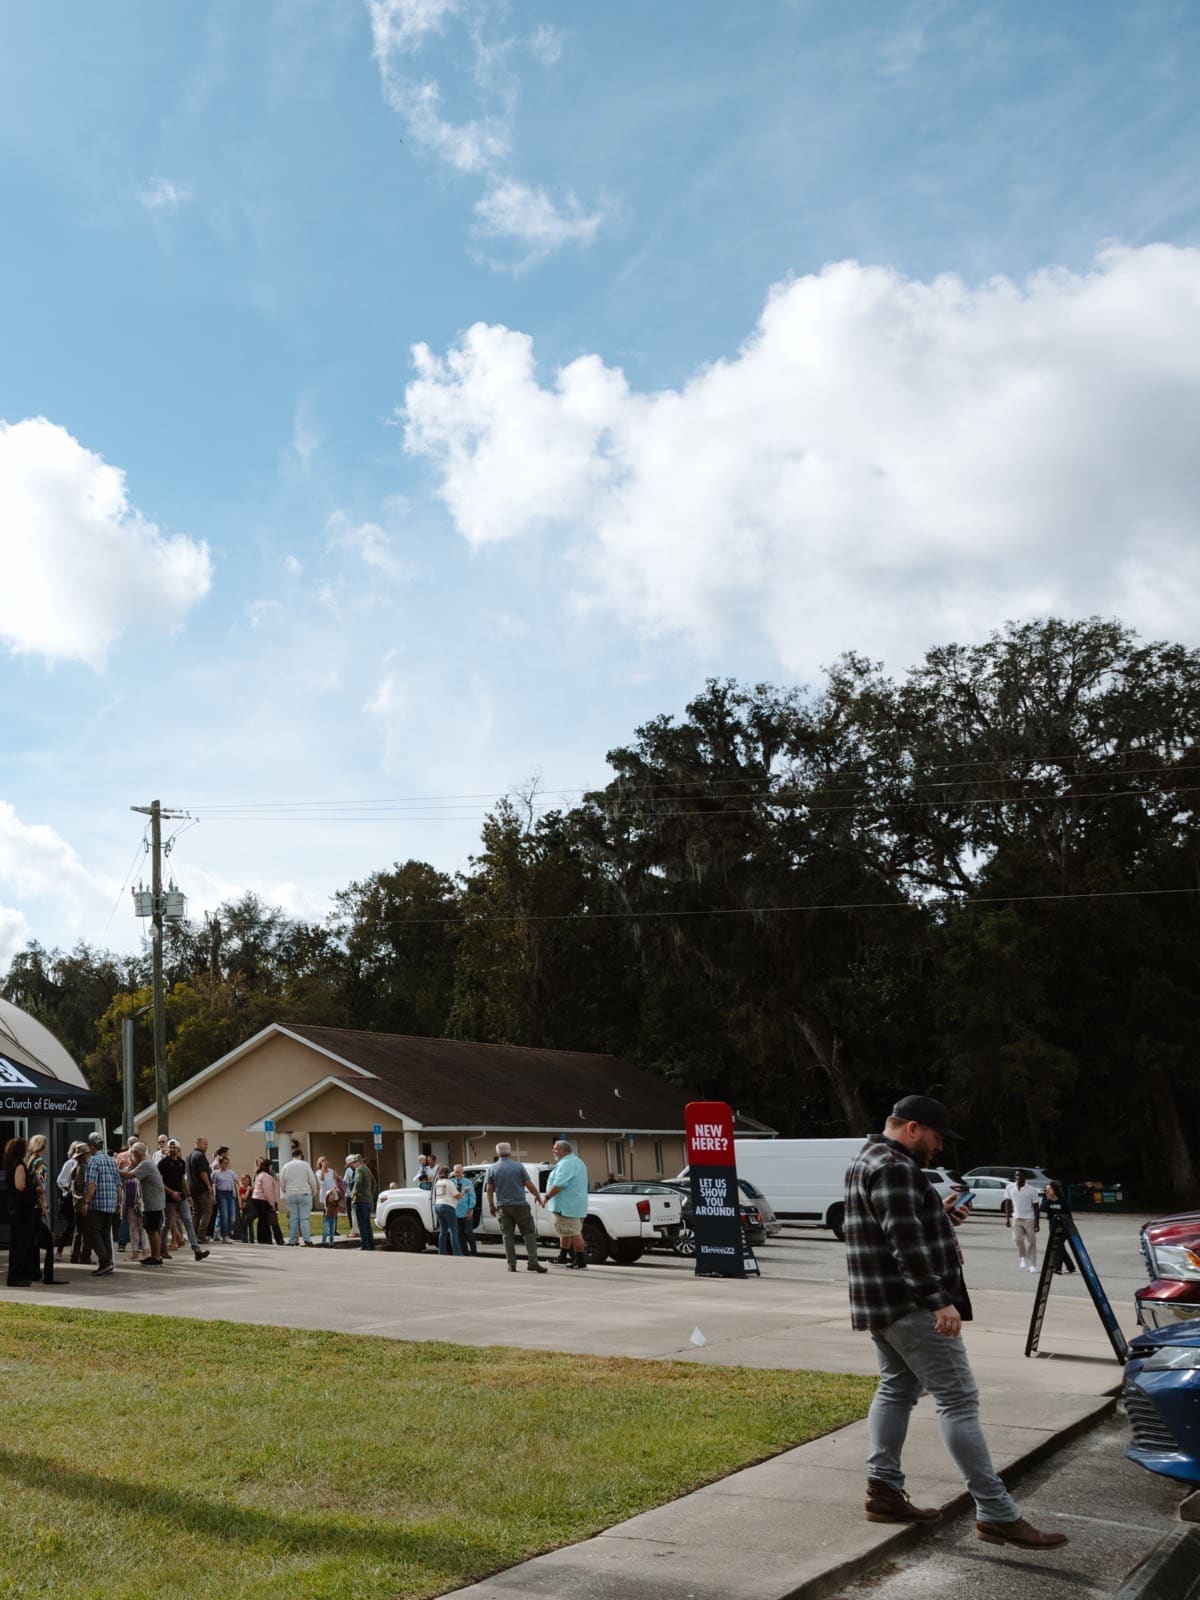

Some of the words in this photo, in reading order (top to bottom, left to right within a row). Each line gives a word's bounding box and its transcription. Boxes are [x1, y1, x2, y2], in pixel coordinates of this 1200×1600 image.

[4, 1097, 32, 1110] Church
[33, 1098, 42, 1110] of
[43, 1098, 78, 1111] Eleven22
[694, 1124, 723, 1137] NEW
[691, 1137, 729, 1151] HERE?
[699, 1178, 713, 1188] LET
[714, 1178, 727, 1188] US
[700, 1188, 727, 1198] SHOW
[705, 1197, 724, 1207] YOU
[695, 1206, 735, 1217] AROUND!
[700, 1245, 736, 1255] Eleven22
